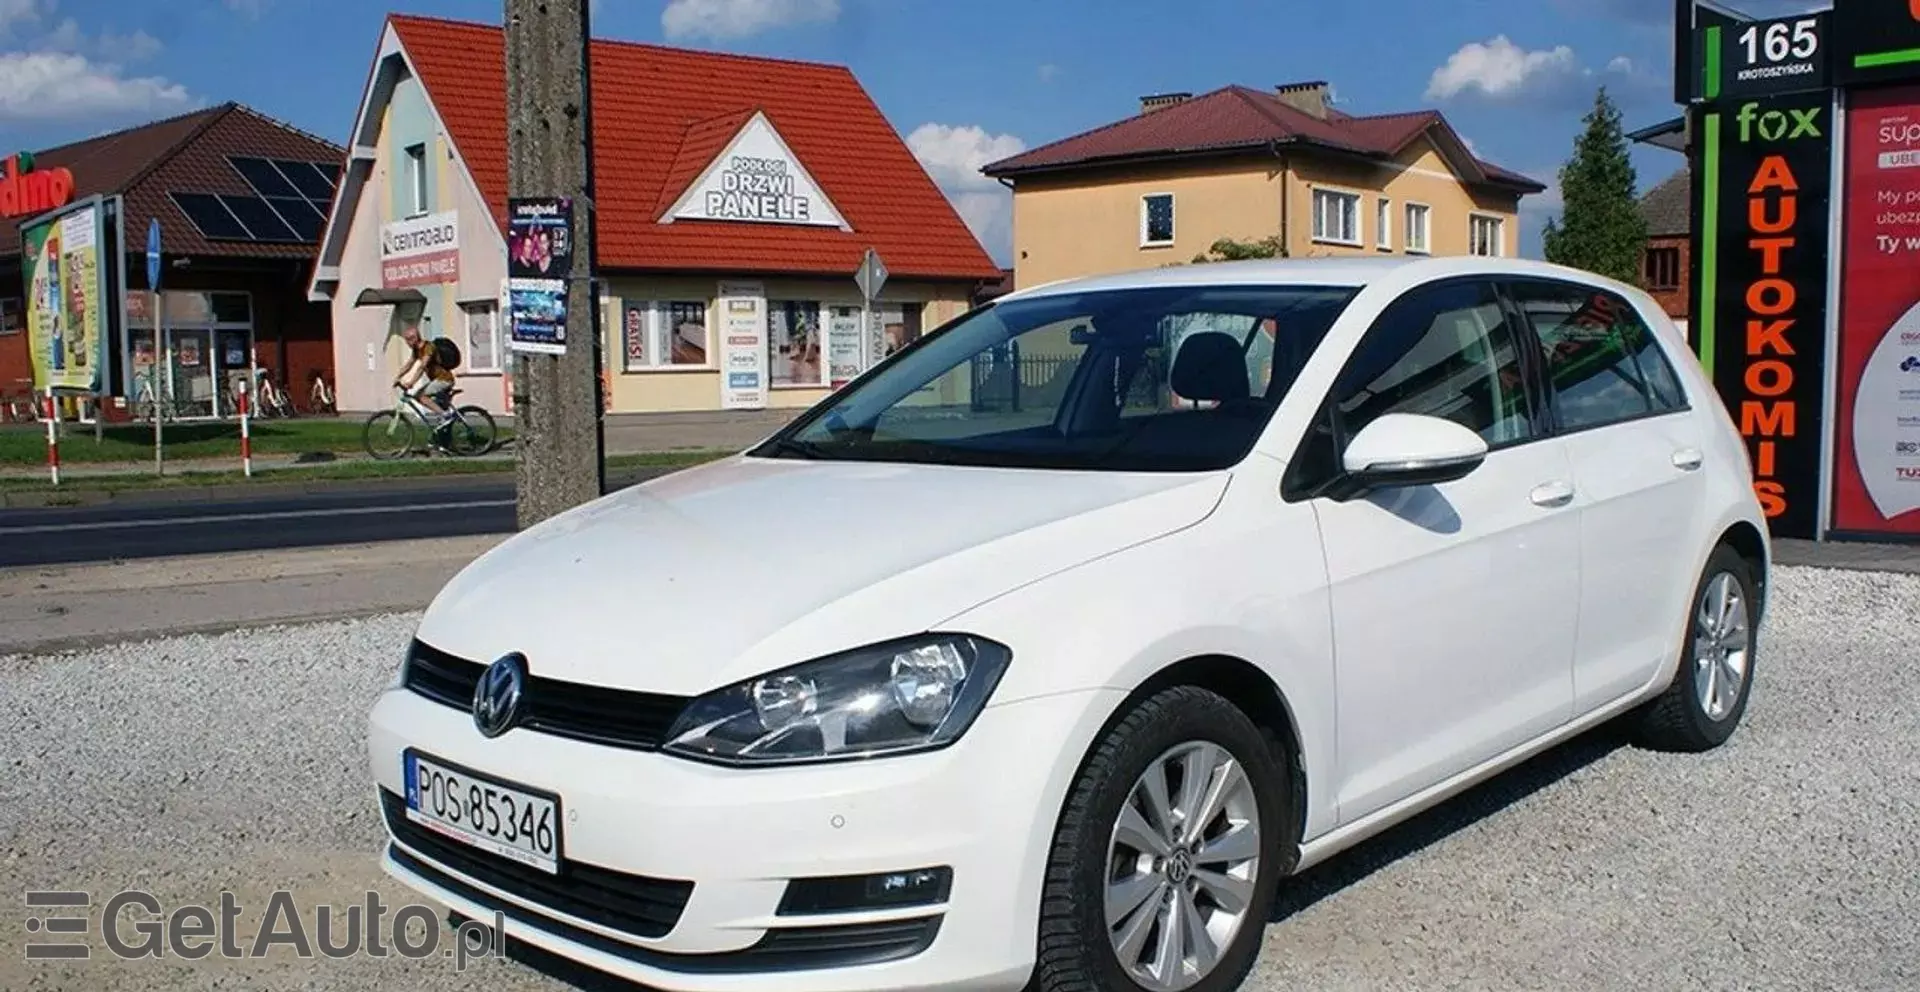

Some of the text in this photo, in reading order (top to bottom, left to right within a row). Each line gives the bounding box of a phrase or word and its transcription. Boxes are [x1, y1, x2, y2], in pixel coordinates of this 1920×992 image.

[1738, 19, 1818, 64] 165
[1737, 63, 1814, 80] KROTOSZYŃSKA
[1735, 102, 1822, 142] fox
[732, 156, 787, 176] PODŁOGI
[0, 153, 74, 217] dino
[722, 169, 795, 197] DRZWI
[705, 190, 810, 220] PANELE
[1877, 190, 1901, 206] My
[1876, 234, 1901, 254] Ty
[418, 764, 461, 823] POS
[469, 784, 553, 855] 85346
